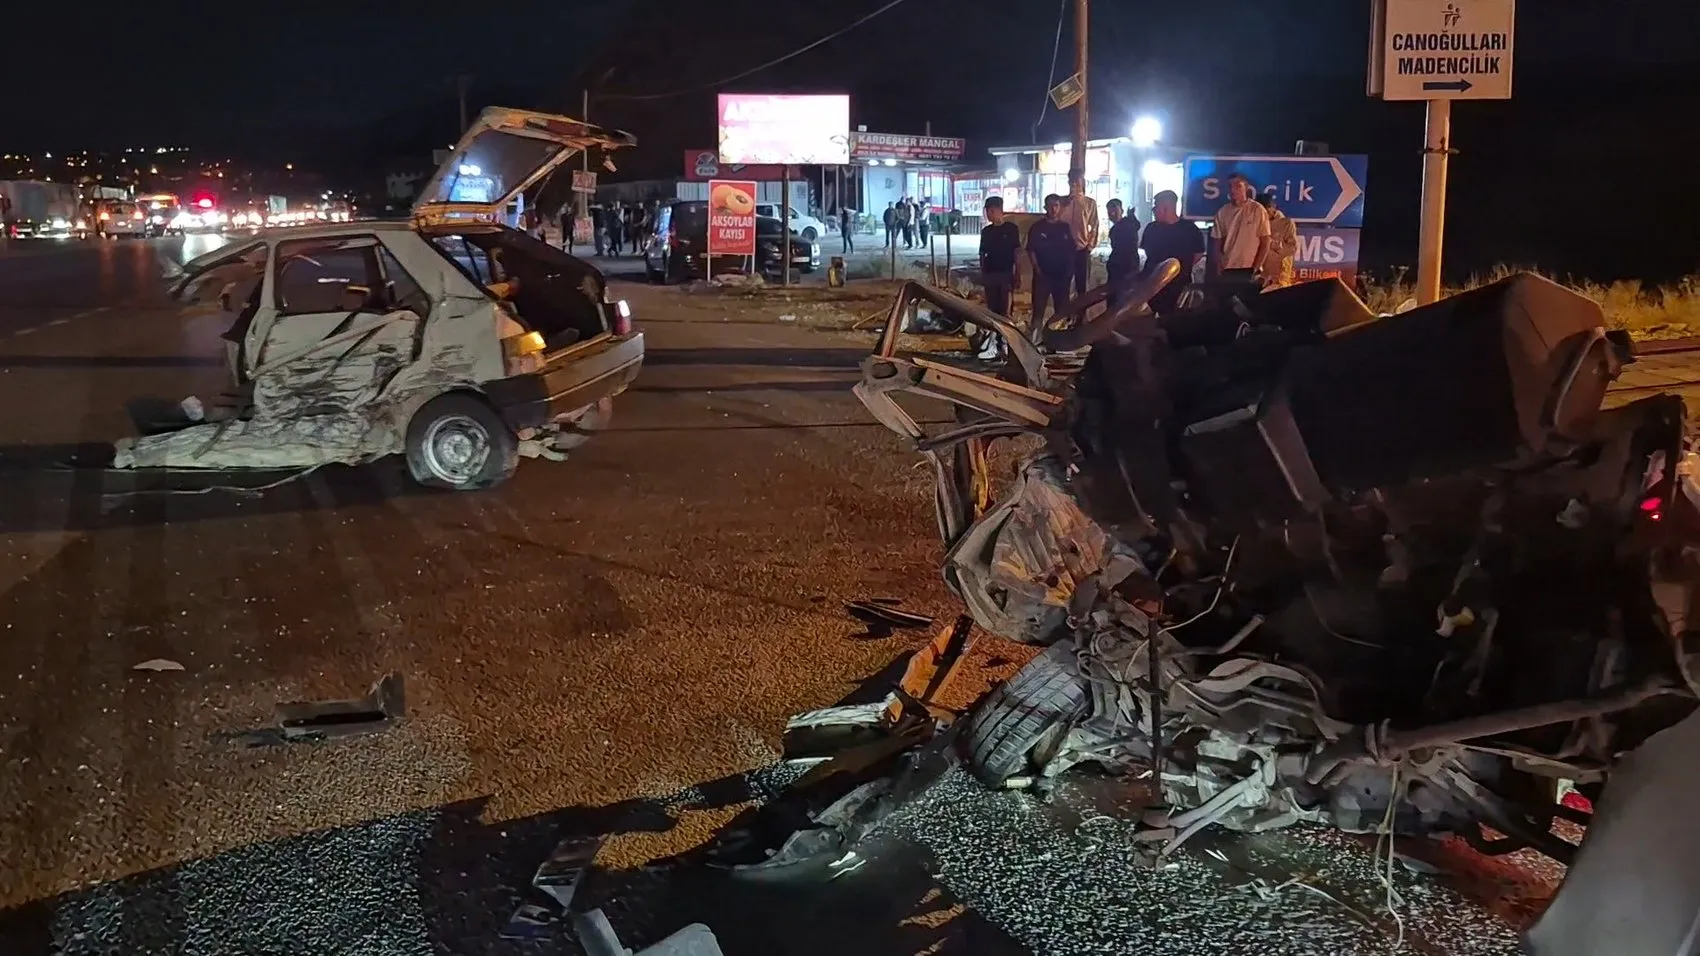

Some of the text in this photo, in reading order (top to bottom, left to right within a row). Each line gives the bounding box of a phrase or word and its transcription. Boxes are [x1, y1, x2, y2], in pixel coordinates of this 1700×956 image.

[1392, 29, 1507, 51] CANOĞULLARI
[1398, 53, 1501, 75] MADENCİLİK
[858, 134, 960, 149] KARDEŞLER MANGAL
[1203, 177, 1314, 202] Sncik
[711, 215, 753, 228] AKSOYLAR
[719, 228, 746, 240] KAYISI
